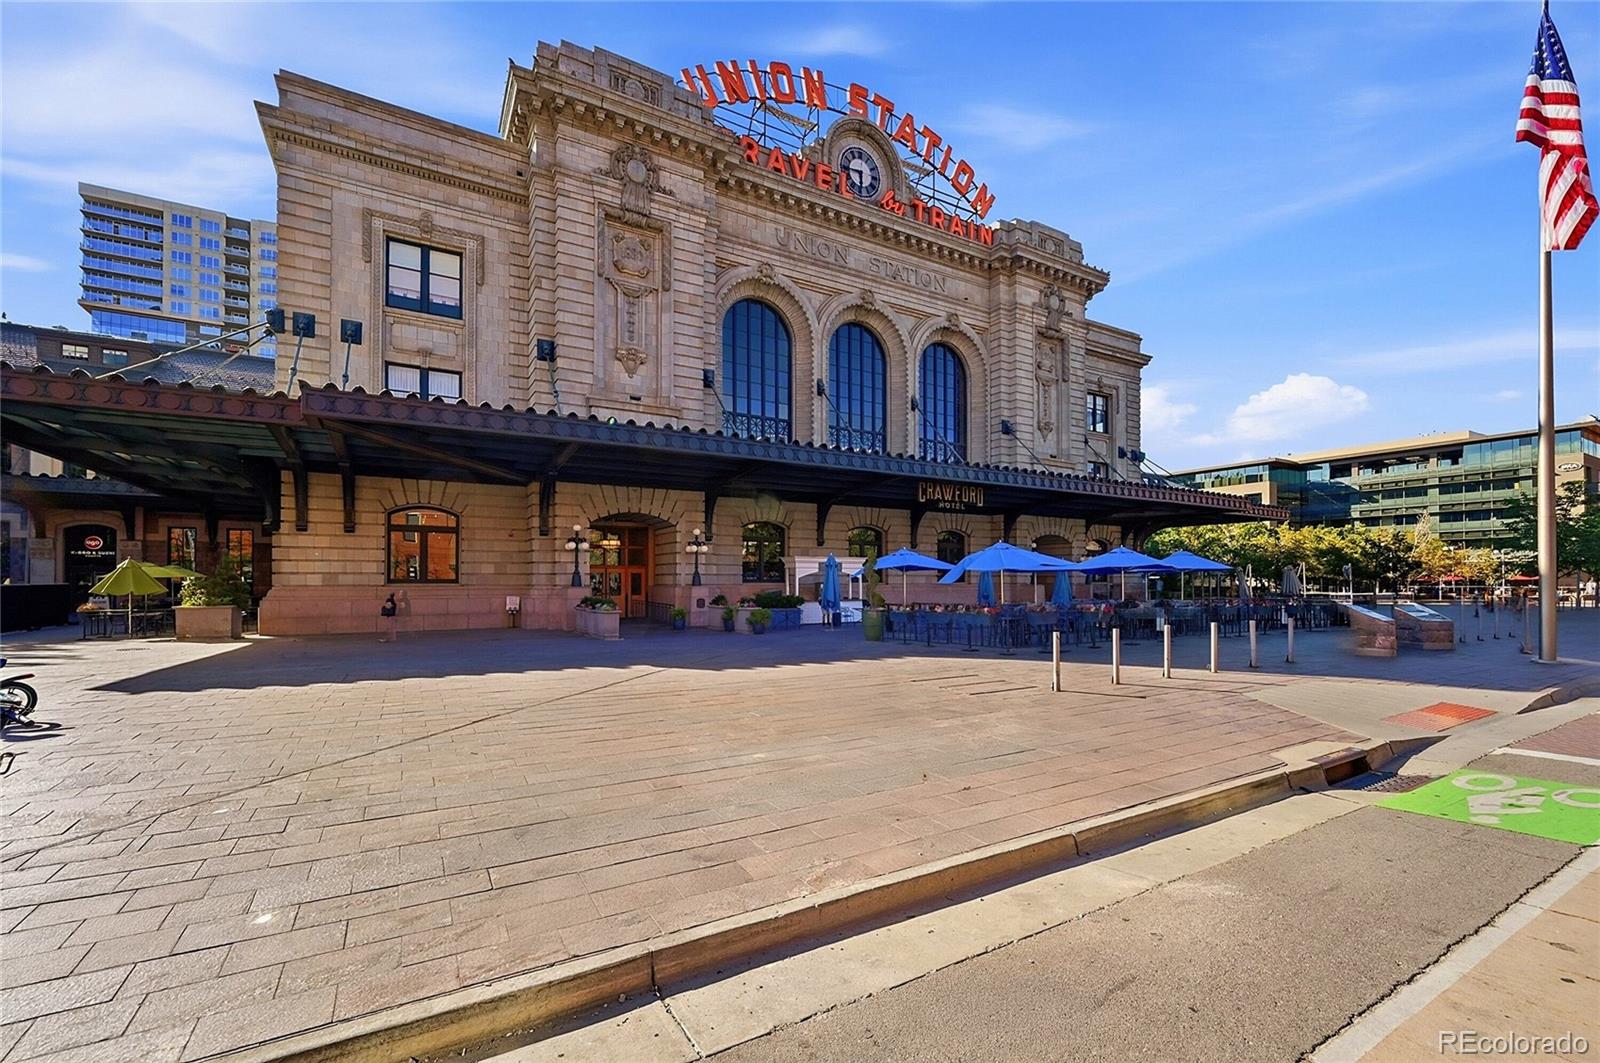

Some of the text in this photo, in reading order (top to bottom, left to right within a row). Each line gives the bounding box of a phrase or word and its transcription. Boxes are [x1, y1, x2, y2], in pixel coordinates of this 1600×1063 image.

[681, 59, 997, 220] UNION STATION
[717, 127, 993, 245] RAVEL by TRAIN
[775, 227, 946, 293] UNION STATION
[919, 481, 984, 507] CRAWFORD
[938, 500, 966, 510] HOTEL
